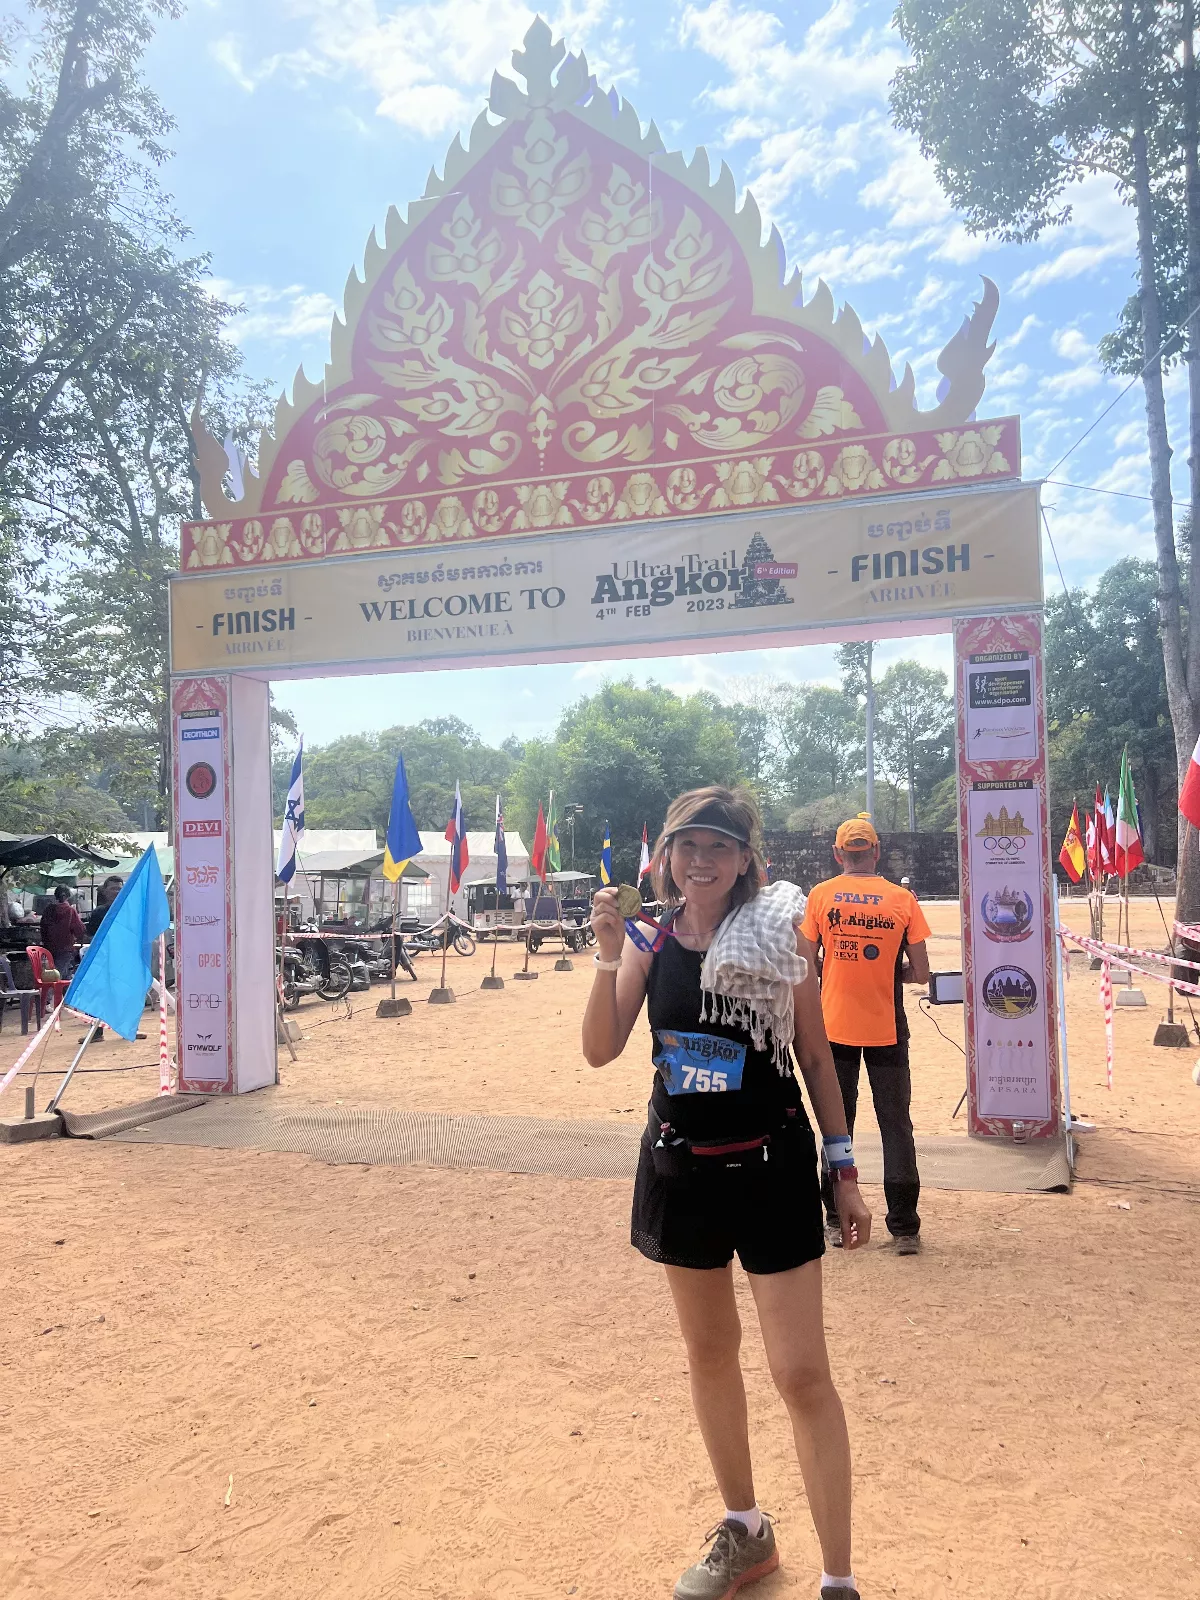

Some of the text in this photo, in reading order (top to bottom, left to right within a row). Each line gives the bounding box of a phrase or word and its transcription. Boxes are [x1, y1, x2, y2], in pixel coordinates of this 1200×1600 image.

[611, 549, 737, 580] Ultra Trail
[769, 567, 796, 575] Edition
[851, 543, 970, 583] FINISH
[590, 565, 747, 607] Angkor
[866, 579, 956, 604] ARRIVÉE
[359, 586, 566, 623] WELCOME TO
[595, 597, 725, 621] 4TH FEB 2023
[212, 607, 295, 636] FINISH
[406, 620, 514, 643] BIENVENUE À
[225, 637, 287, 655] ARRIVÉE
[974, 652, 1023, 662] ORGANIZED BY
[974, 697, 1027, 706] www.sdpo.com
[184, 729, 218, 739] DECATHLON
[977, 782, 1017, 790] SUPPORTED
[185, 822, 219, 832] DEVI
[833, 892, 884, 906] STAFF
[187, 1044, 222, 1052] GYMWOLF
[681, 1065, 728, 1093] 755
[989, 1086, 1037, 1094] APSARA
